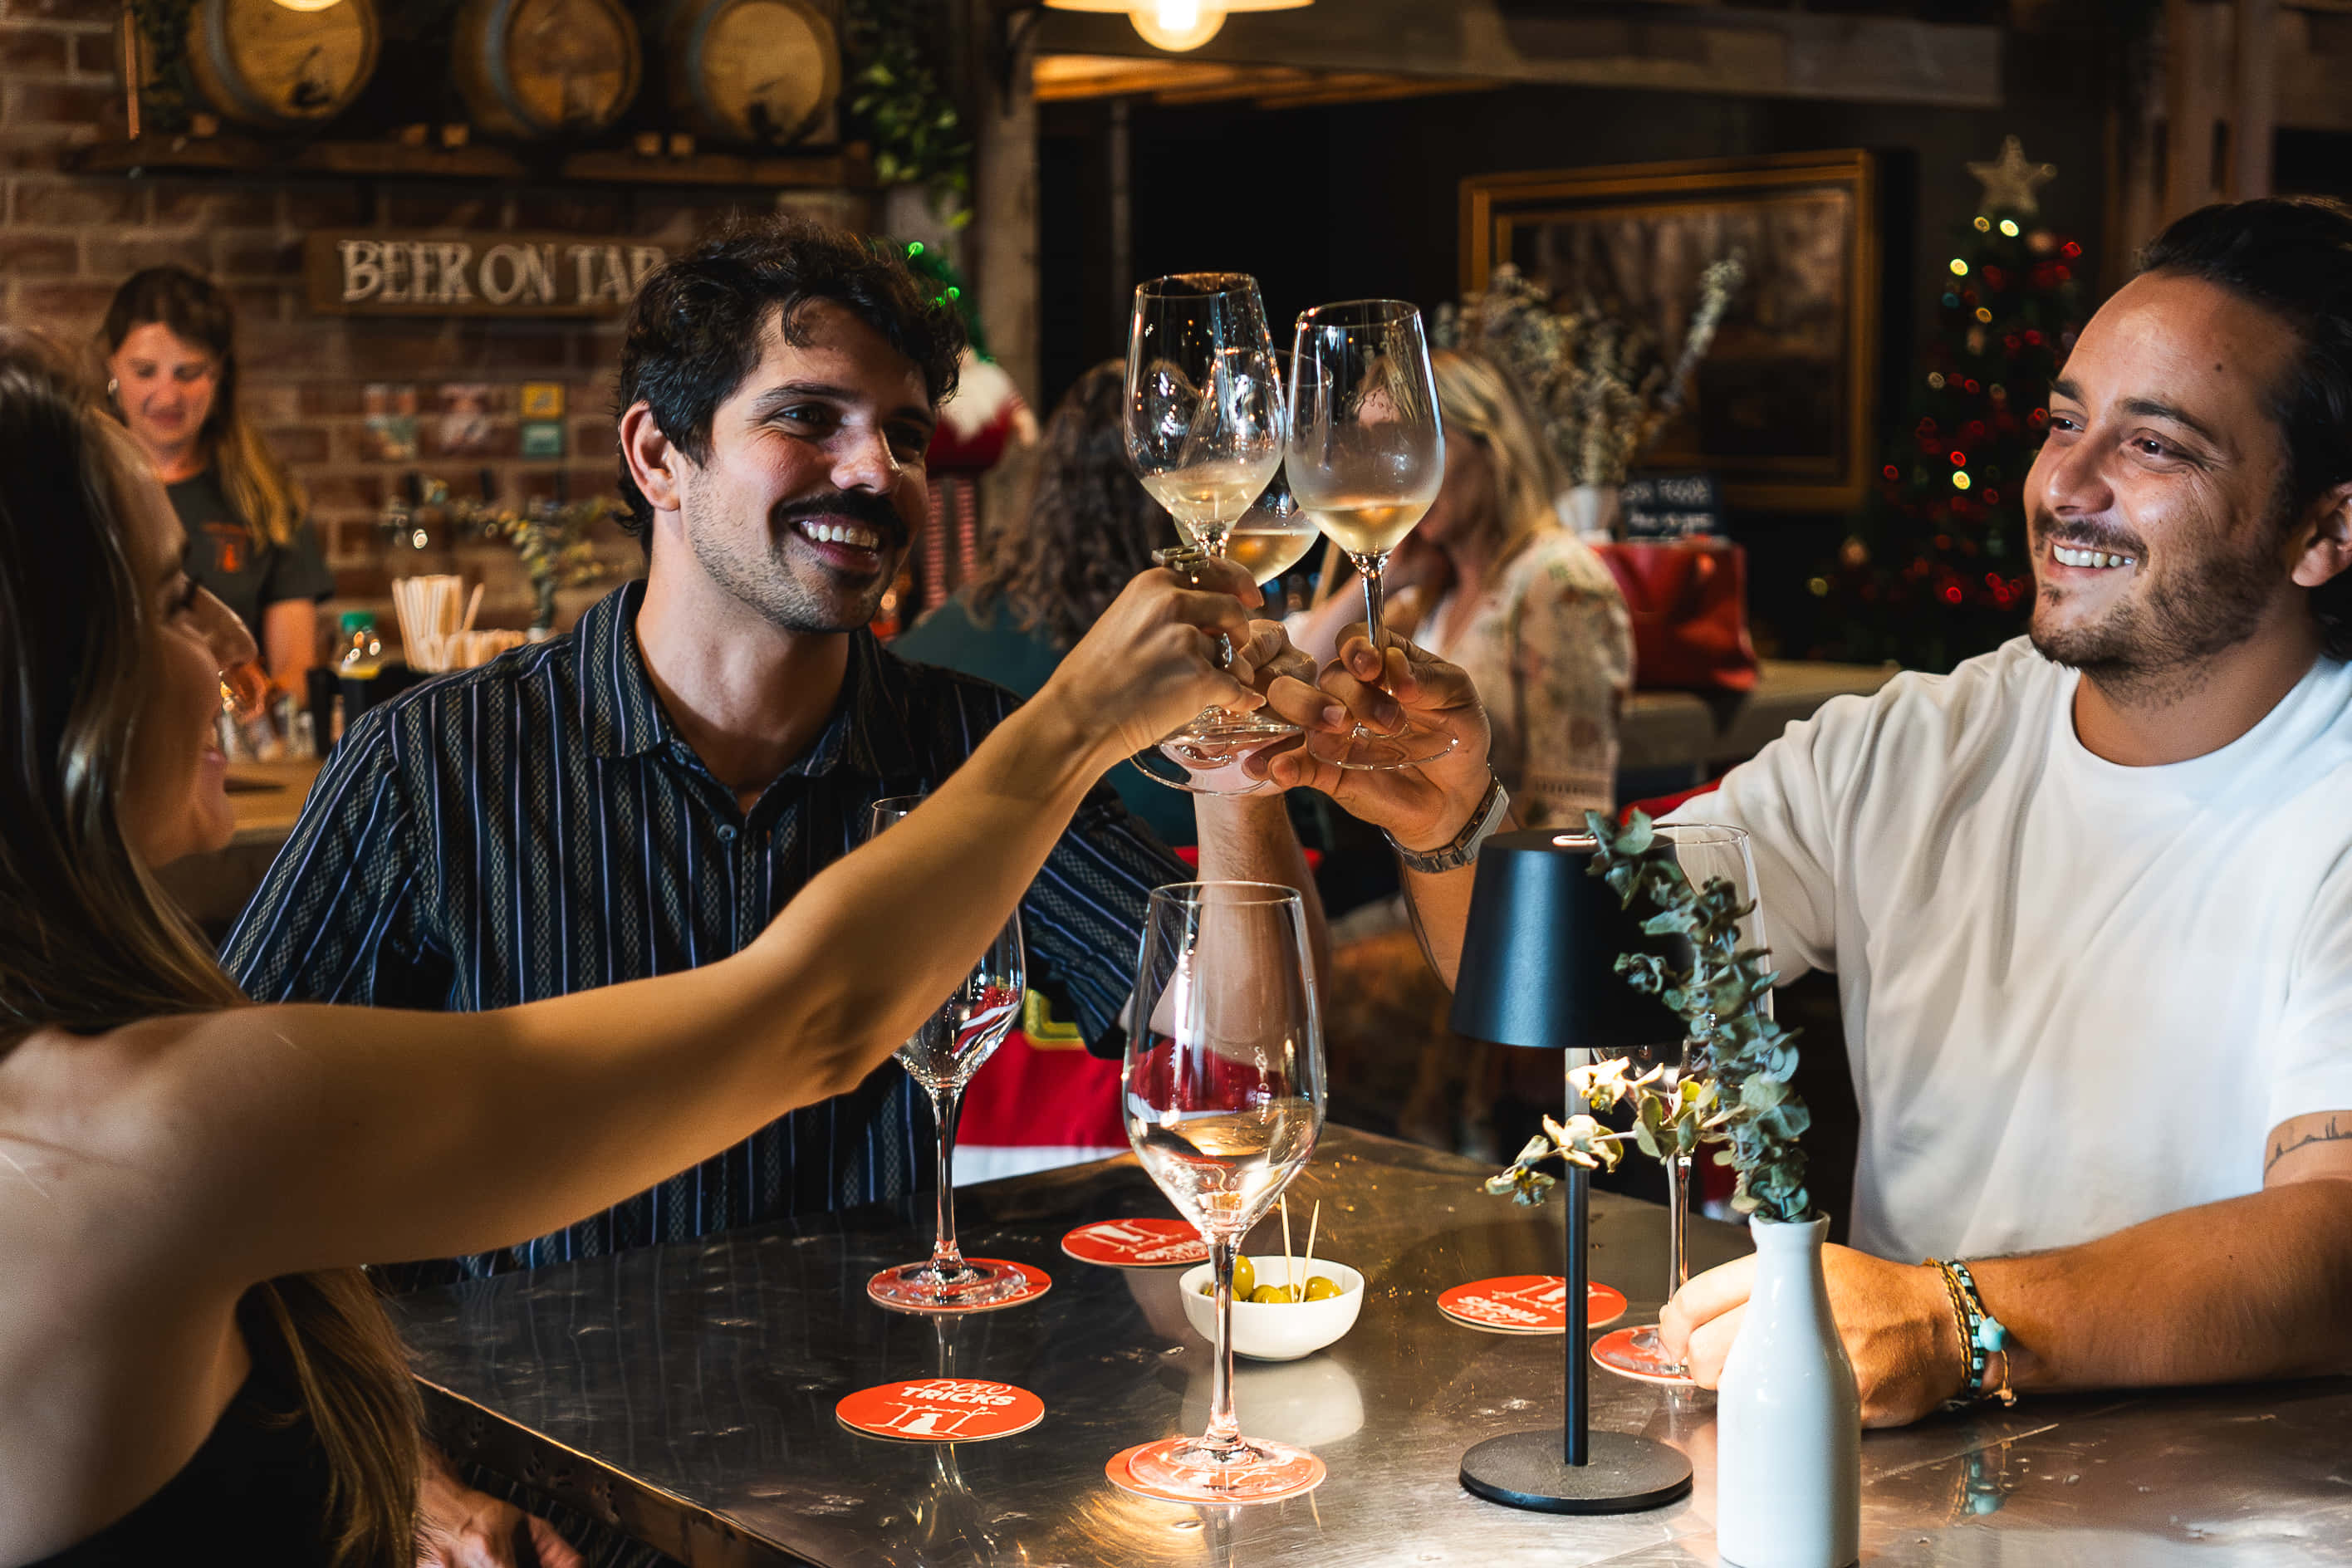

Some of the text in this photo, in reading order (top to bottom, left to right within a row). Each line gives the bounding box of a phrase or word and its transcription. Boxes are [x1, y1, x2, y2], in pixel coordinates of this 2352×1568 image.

[337, 240, 473, 304] BEER
[478, 243, 556, 306] ON
[900, 1385, 1017, 1406] TRICKS
